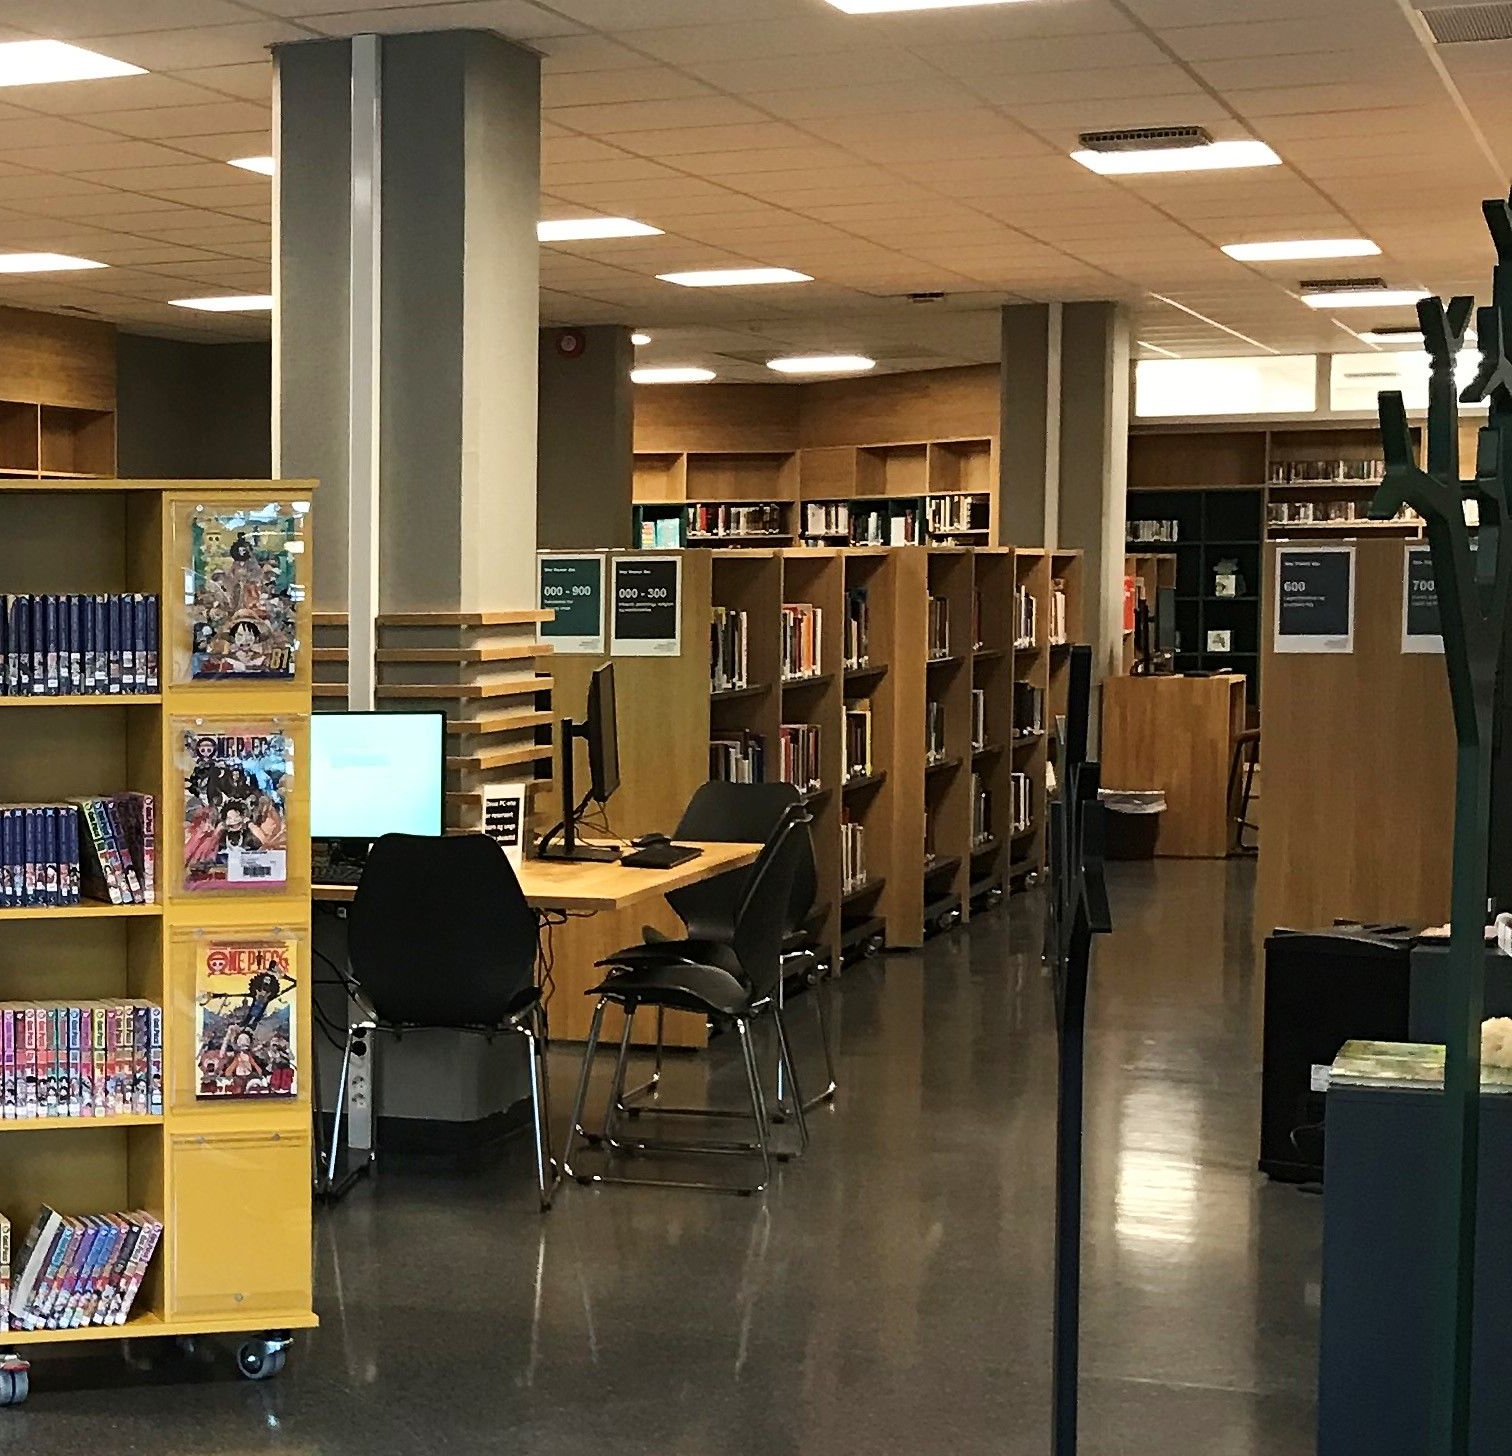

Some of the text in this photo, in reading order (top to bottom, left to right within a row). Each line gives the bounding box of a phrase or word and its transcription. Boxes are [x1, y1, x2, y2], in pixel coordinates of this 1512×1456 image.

[544, 586, 563, 596] 000
[572, 585, 591, 596] 900
[1284, 581, 1306, 592] 600
[1413, 580, 1435, 591] 700
[619, 588, 638, 599] 000
[647, 587, 667, 599] 300
